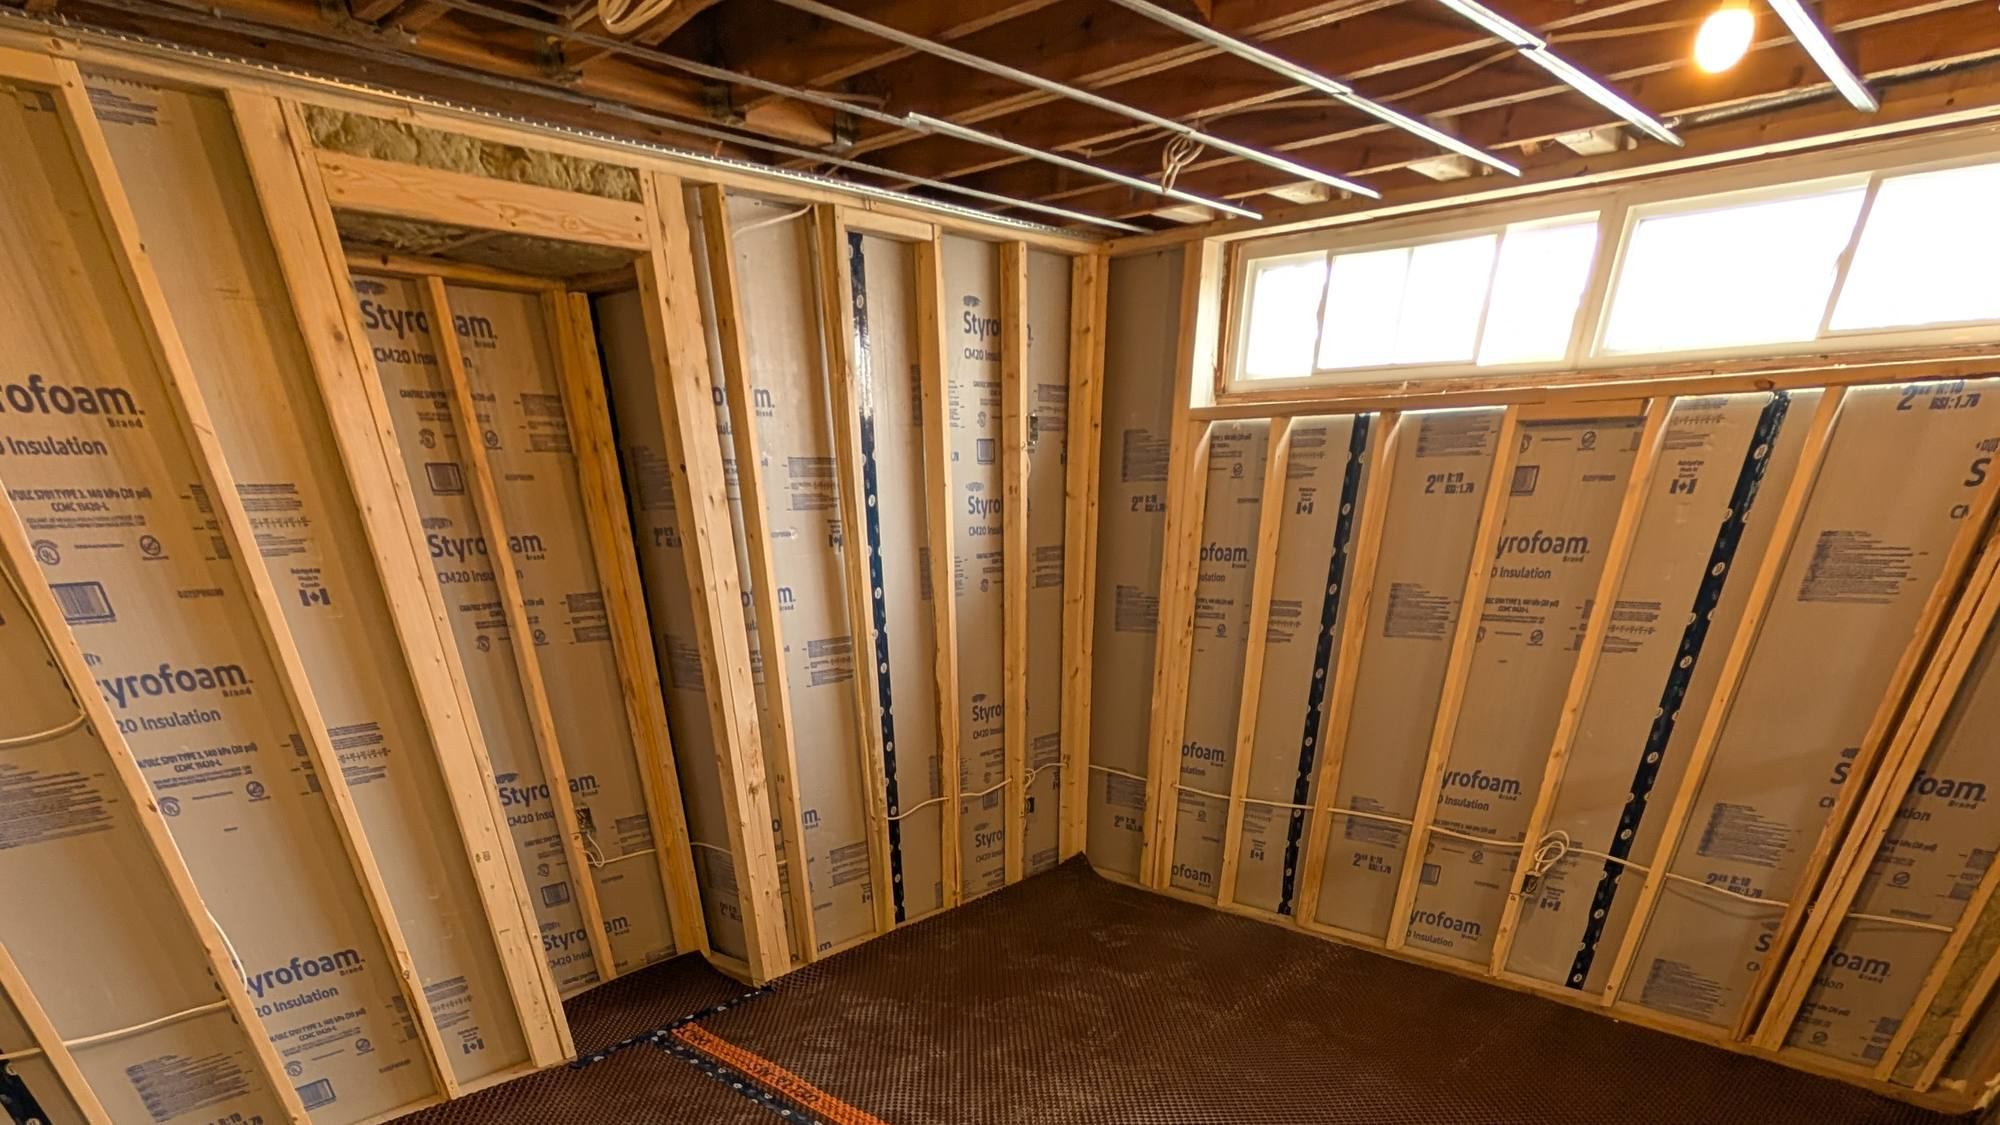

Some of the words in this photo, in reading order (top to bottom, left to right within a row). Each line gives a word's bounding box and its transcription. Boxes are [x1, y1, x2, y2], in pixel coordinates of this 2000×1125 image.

[360, 300, 497, 339] Styroam
[0, 374, 145, 415] ofoam
[6, 435, 107, 455] Insulation
[54, 489, 78, 500] TYPE
[428, 534, 547, 562] Styroam
[1200, 542, 1249, 562] ofoam
[1496, 529, 1589, 559] yrofoam
[1500, 566, 1551, 579] Insulation
[97, 663, 254, 708] yrofoam
[116, 719, 137, 735] 20
[139, 708, 222, 731] Insulation
[1182, 742, 1226, 763] ofoam
[499, 774, 600, 807] Styroam
[1441, 770, 1522, 796] yrofoam
[1444, 795, 1489, 811] Insulation
[1172, 864, 1213, 884] ofoam
[1409, 909, 1482, 937] yrofoam
[1413, 930, 1453, 948] Insulation
[247, 948, 366, 998] yrofoam
[256, 1006, 272, 1018] 20
[274, 986, 339, 1014] Insulation
